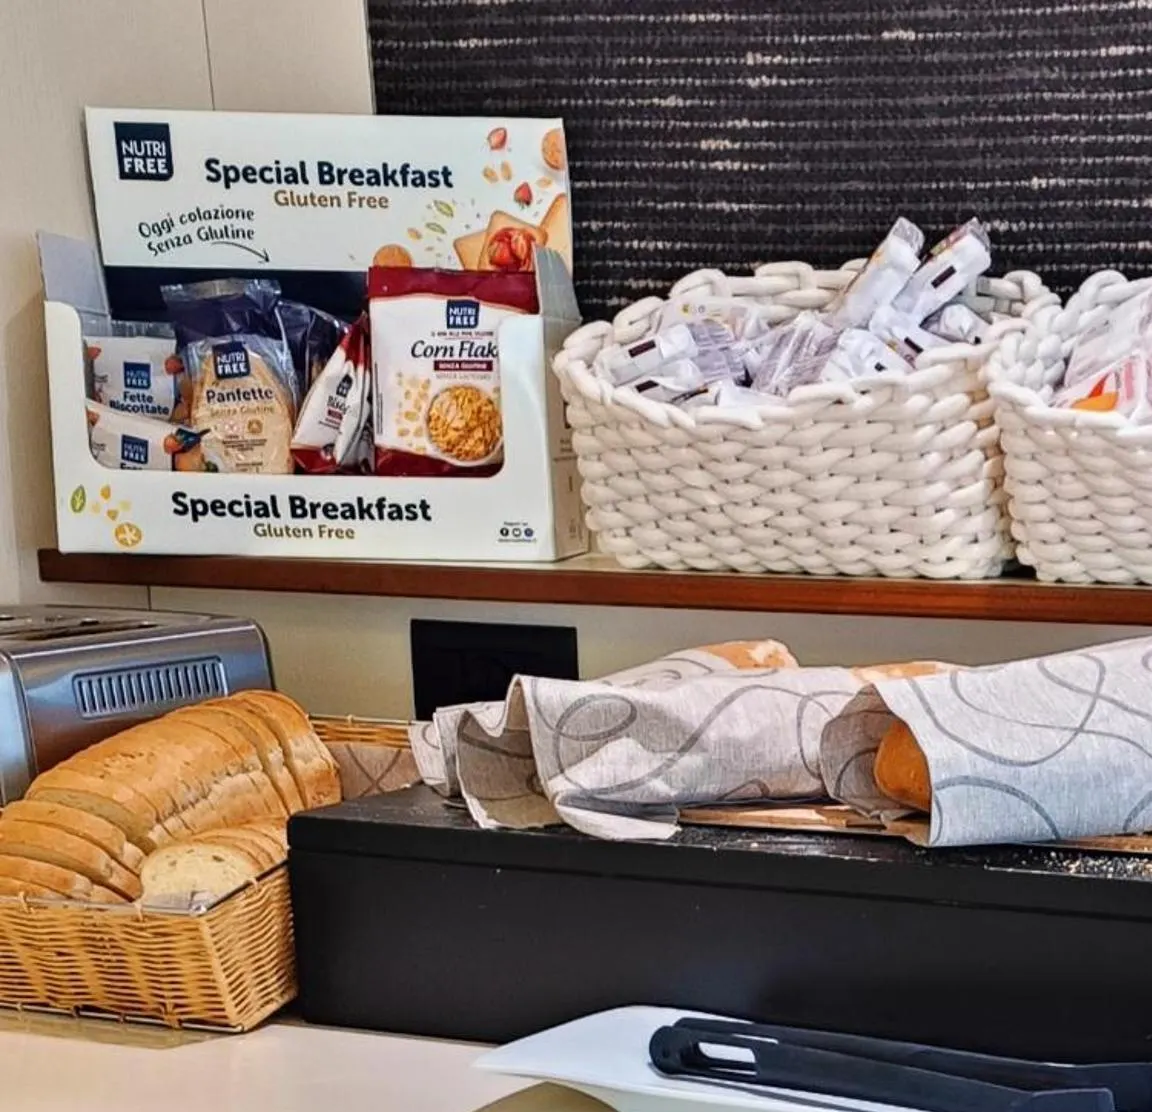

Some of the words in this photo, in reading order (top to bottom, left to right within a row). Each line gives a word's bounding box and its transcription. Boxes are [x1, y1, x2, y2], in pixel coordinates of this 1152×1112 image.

[121, 139, 166, 157] NUTRI
[123, 157, 169, 175] FREE
[204, 157, 309, 190] Special
[317, 160, 454, 189] Breakfast
[273, 189, 342, 208] Gluten
[347, 191, 390, 209] Free
[138, 212, 175, 239] Oggi
[179, 204, 255, 226] colazione
[147, 232, 193, 257] Senza
[197, 225, 255, 243] Glutine
[448, 306, 477, 316] NUTRI
[449, 315, 476, 326] FREE
[216, 352, 246, 364] NUTRI
[410, 339, 455, 359] Corn
[457, 340, 499, 359] Flak
[216, 363, 248, 374] FREE
[123, 391, 154, 404] Fette
[206, 386, 274, 404] Panfette
[109, 399, 170, 416] Biscottate
[171, 491, 281, 523] Special
[288, 495, 432, 522] Breakfast
[253, 523, 314, 539] Gluten
[318, 525, 356, 540] Free
